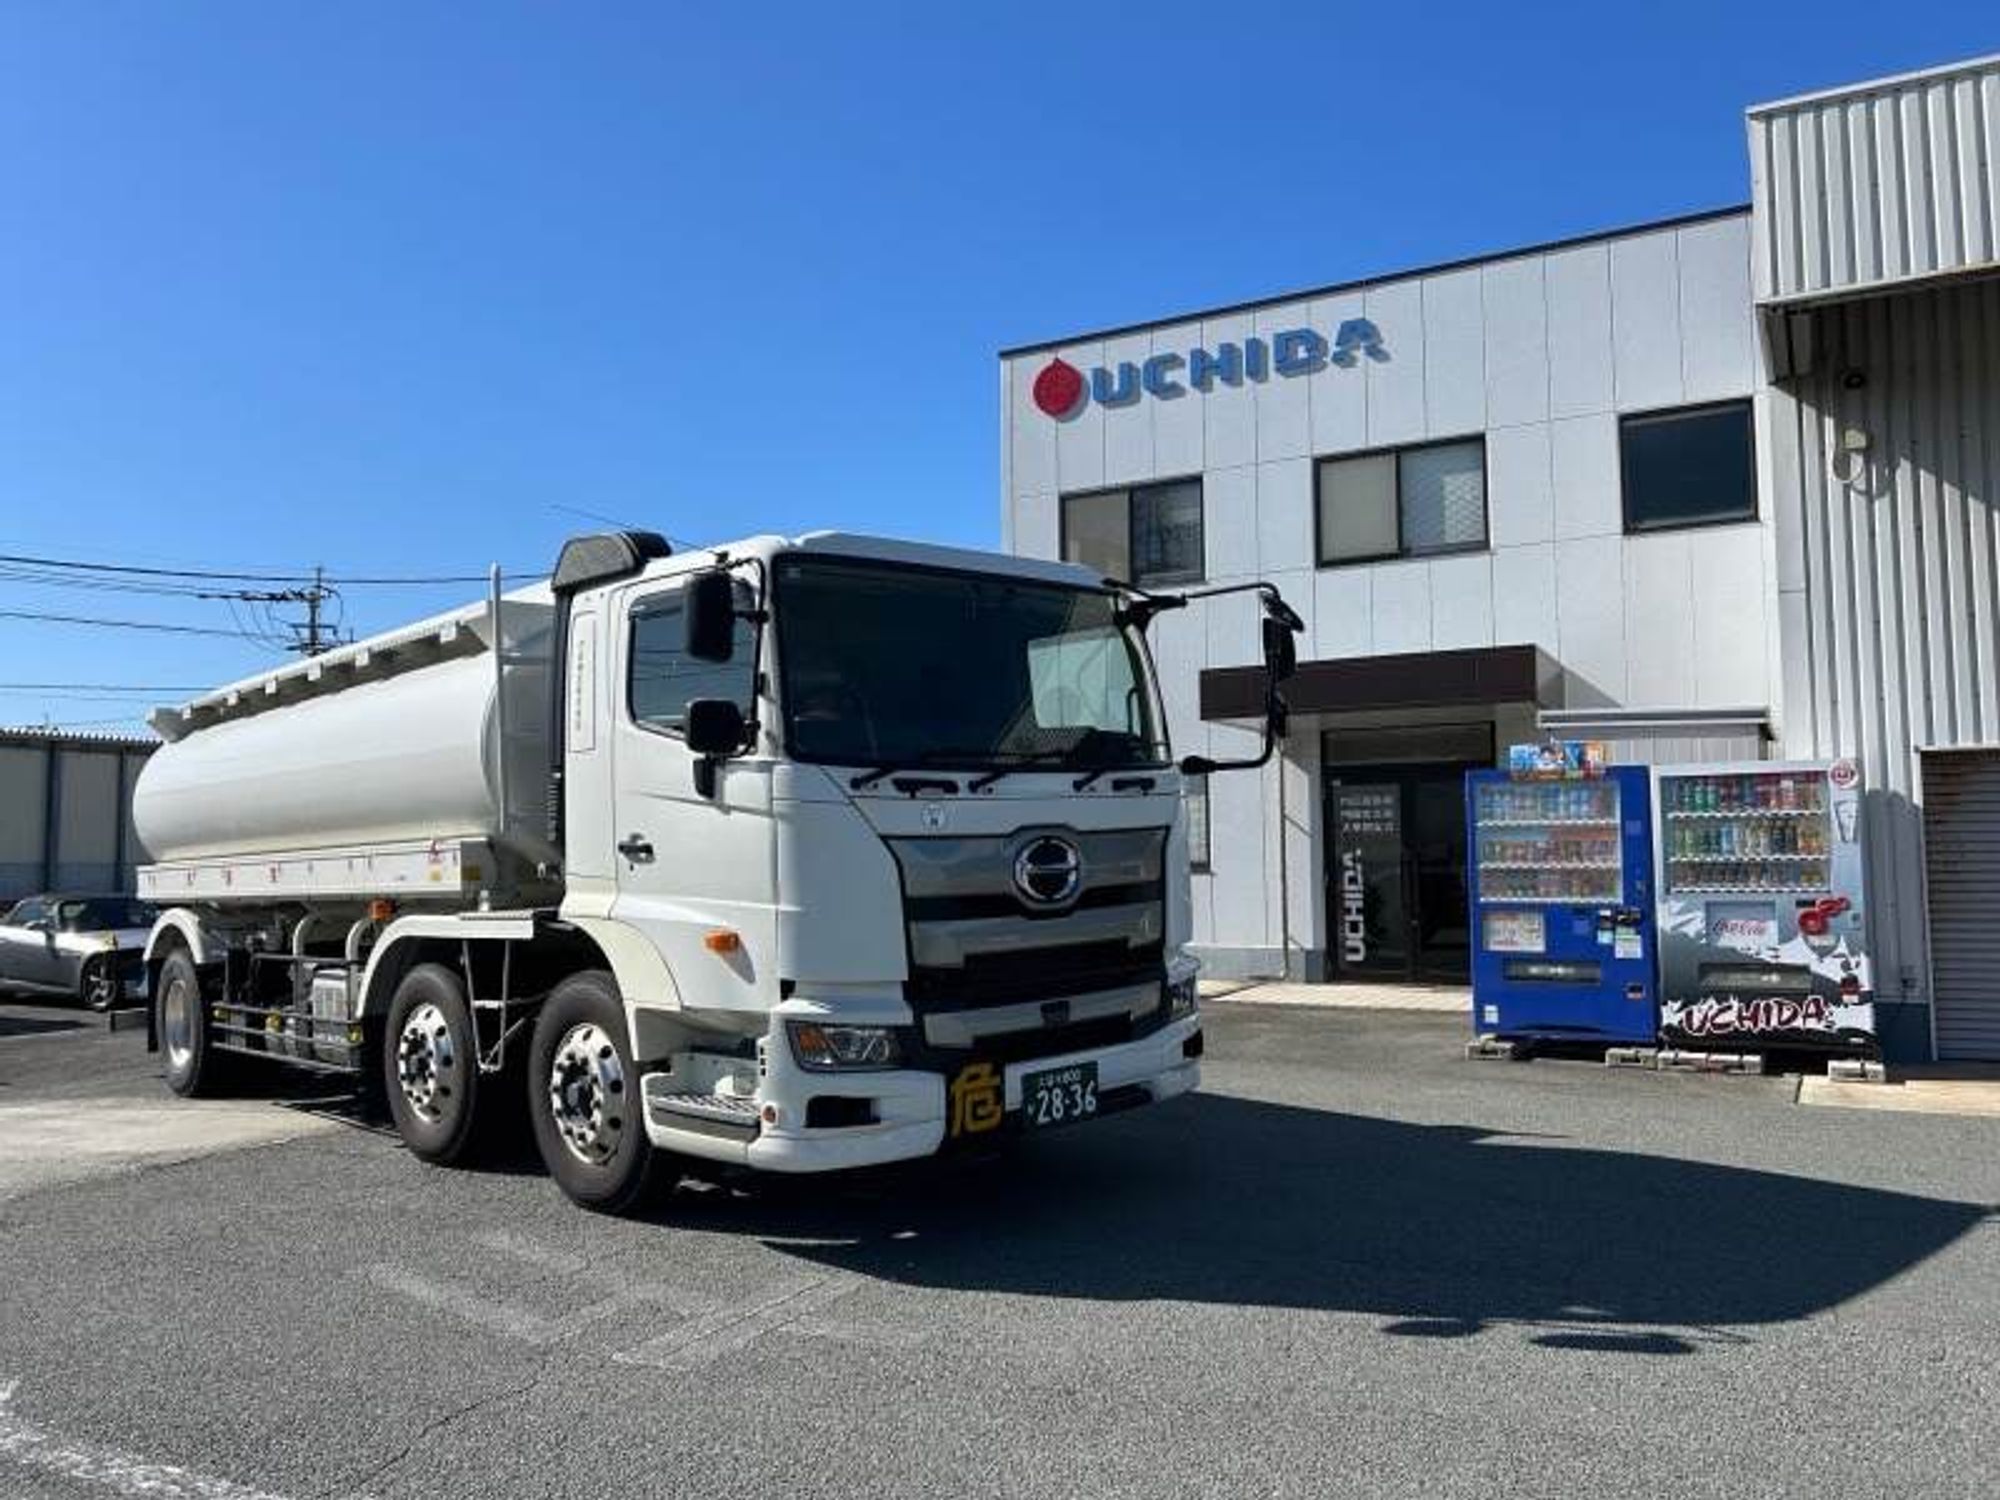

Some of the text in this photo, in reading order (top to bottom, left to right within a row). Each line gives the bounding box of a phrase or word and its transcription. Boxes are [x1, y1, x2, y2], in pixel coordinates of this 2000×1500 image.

[1091, 318, 1389, 408] UCHIDA
[1342, 848, 1367, 962] UCHIDA
[1682, 995, 1825, 1036] UCHIDA
[951, 1061, 1002, 1138] 危
